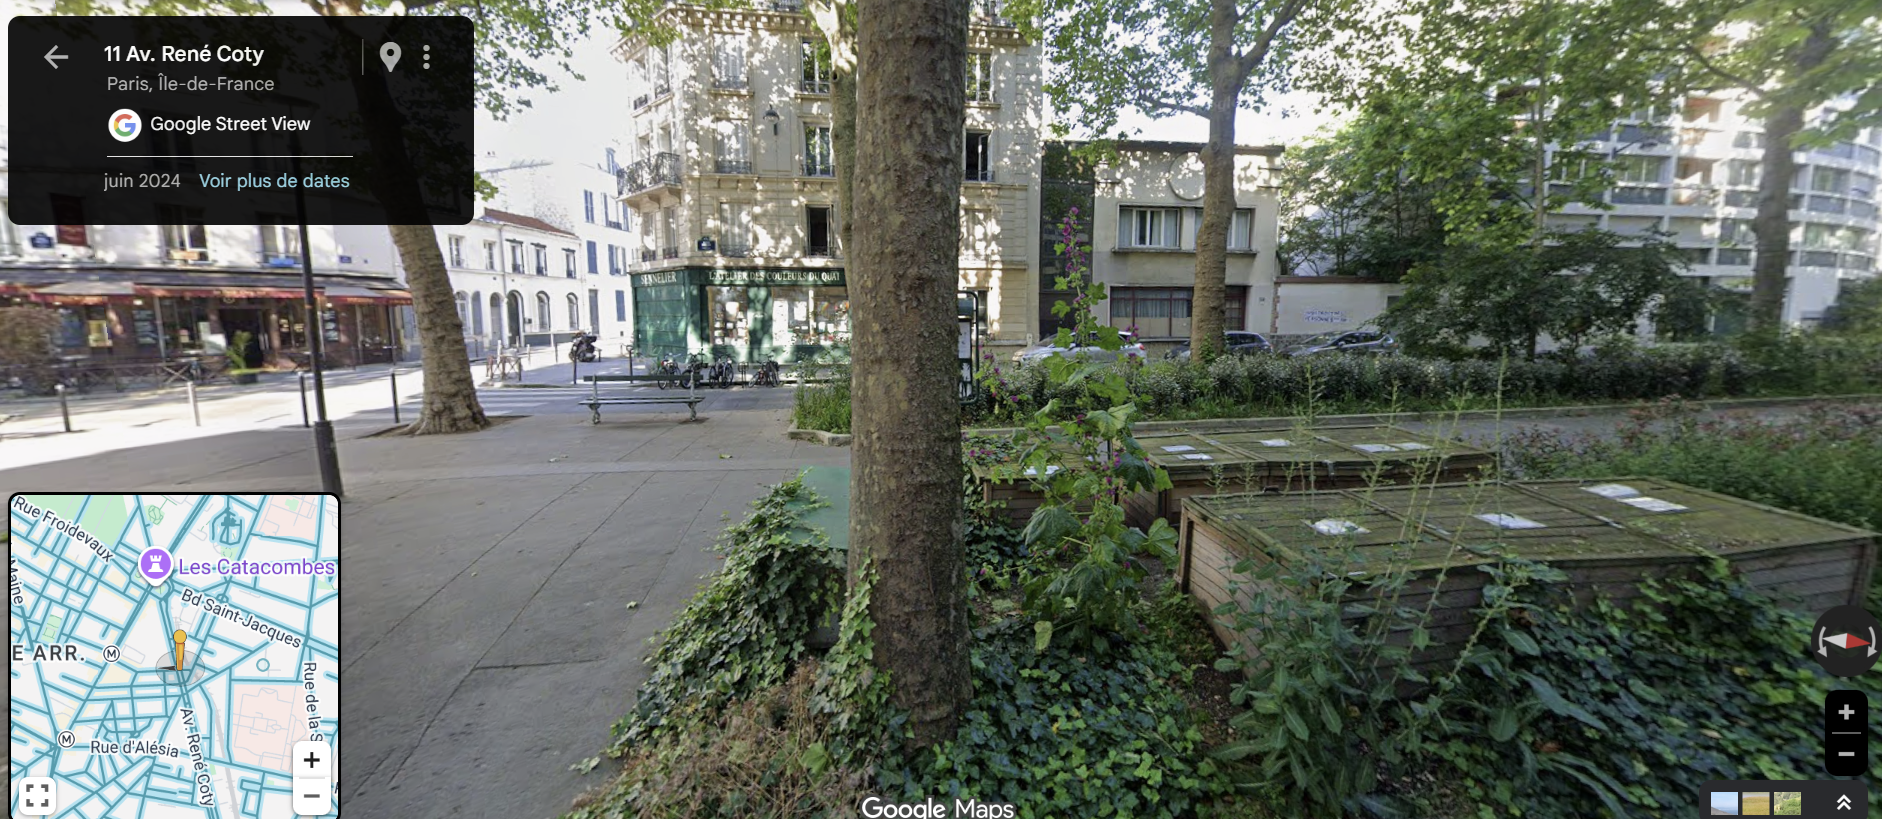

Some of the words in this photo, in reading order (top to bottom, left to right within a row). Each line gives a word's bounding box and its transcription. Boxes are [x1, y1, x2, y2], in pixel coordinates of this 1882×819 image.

[640, 271, 677, 286] SENNELIER
[709, 271, 748, 281] L'ATELIER
[750, 271, 765, 281] DES
[766, 271, 807, 281] COULEURS
[808, 271, 820, 281] DU
